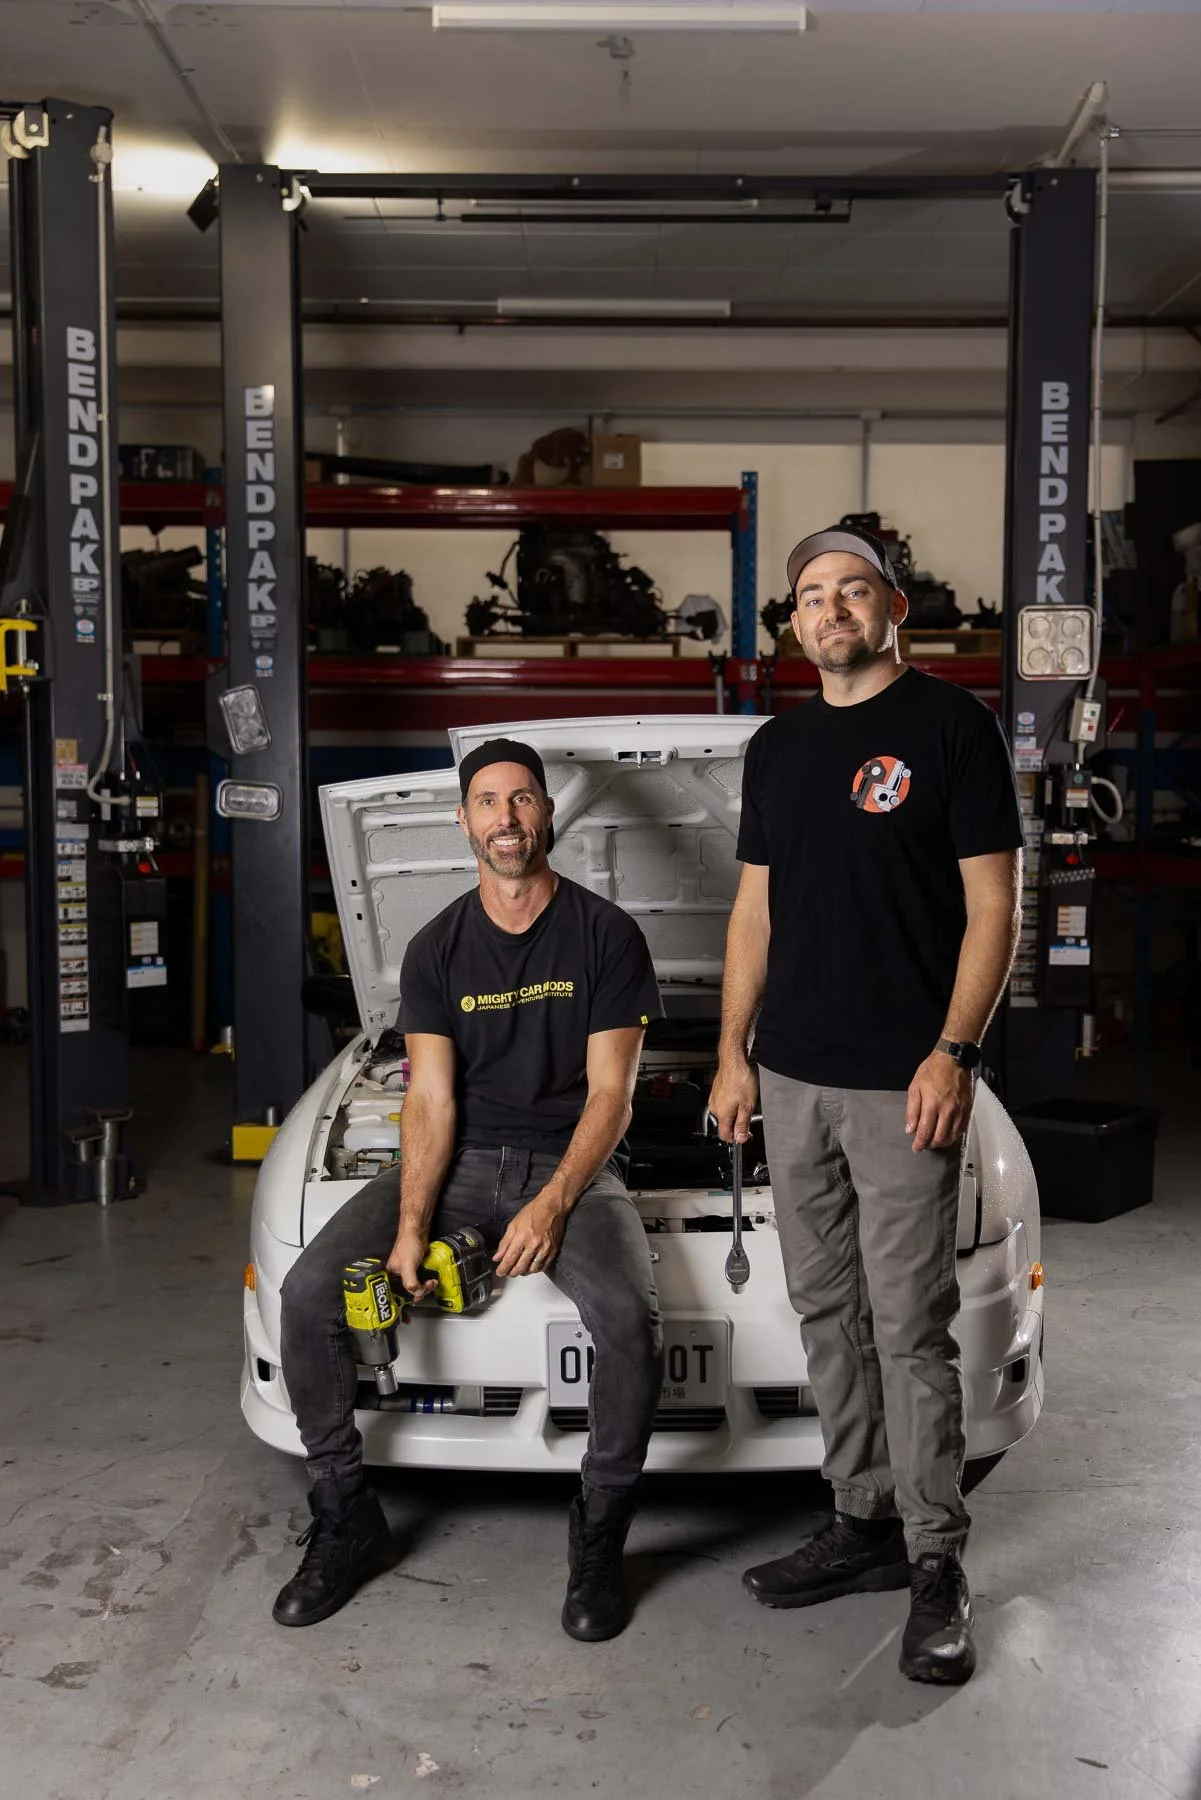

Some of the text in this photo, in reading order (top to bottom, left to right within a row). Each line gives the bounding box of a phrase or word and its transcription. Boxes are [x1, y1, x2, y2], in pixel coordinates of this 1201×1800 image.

[66, 326, 100, 576] BENDPAK
[244, 385, 277, 611] BENDPAK
[1036, 381, 1070, 604] BENDPAK
[477, 989, 519, 1005] MIGHTY
[519, 984, 542, 998] CAR
[511, 993, 544, 1007] VENTURE
[375, 1282, 391, 1321] RYOBI
